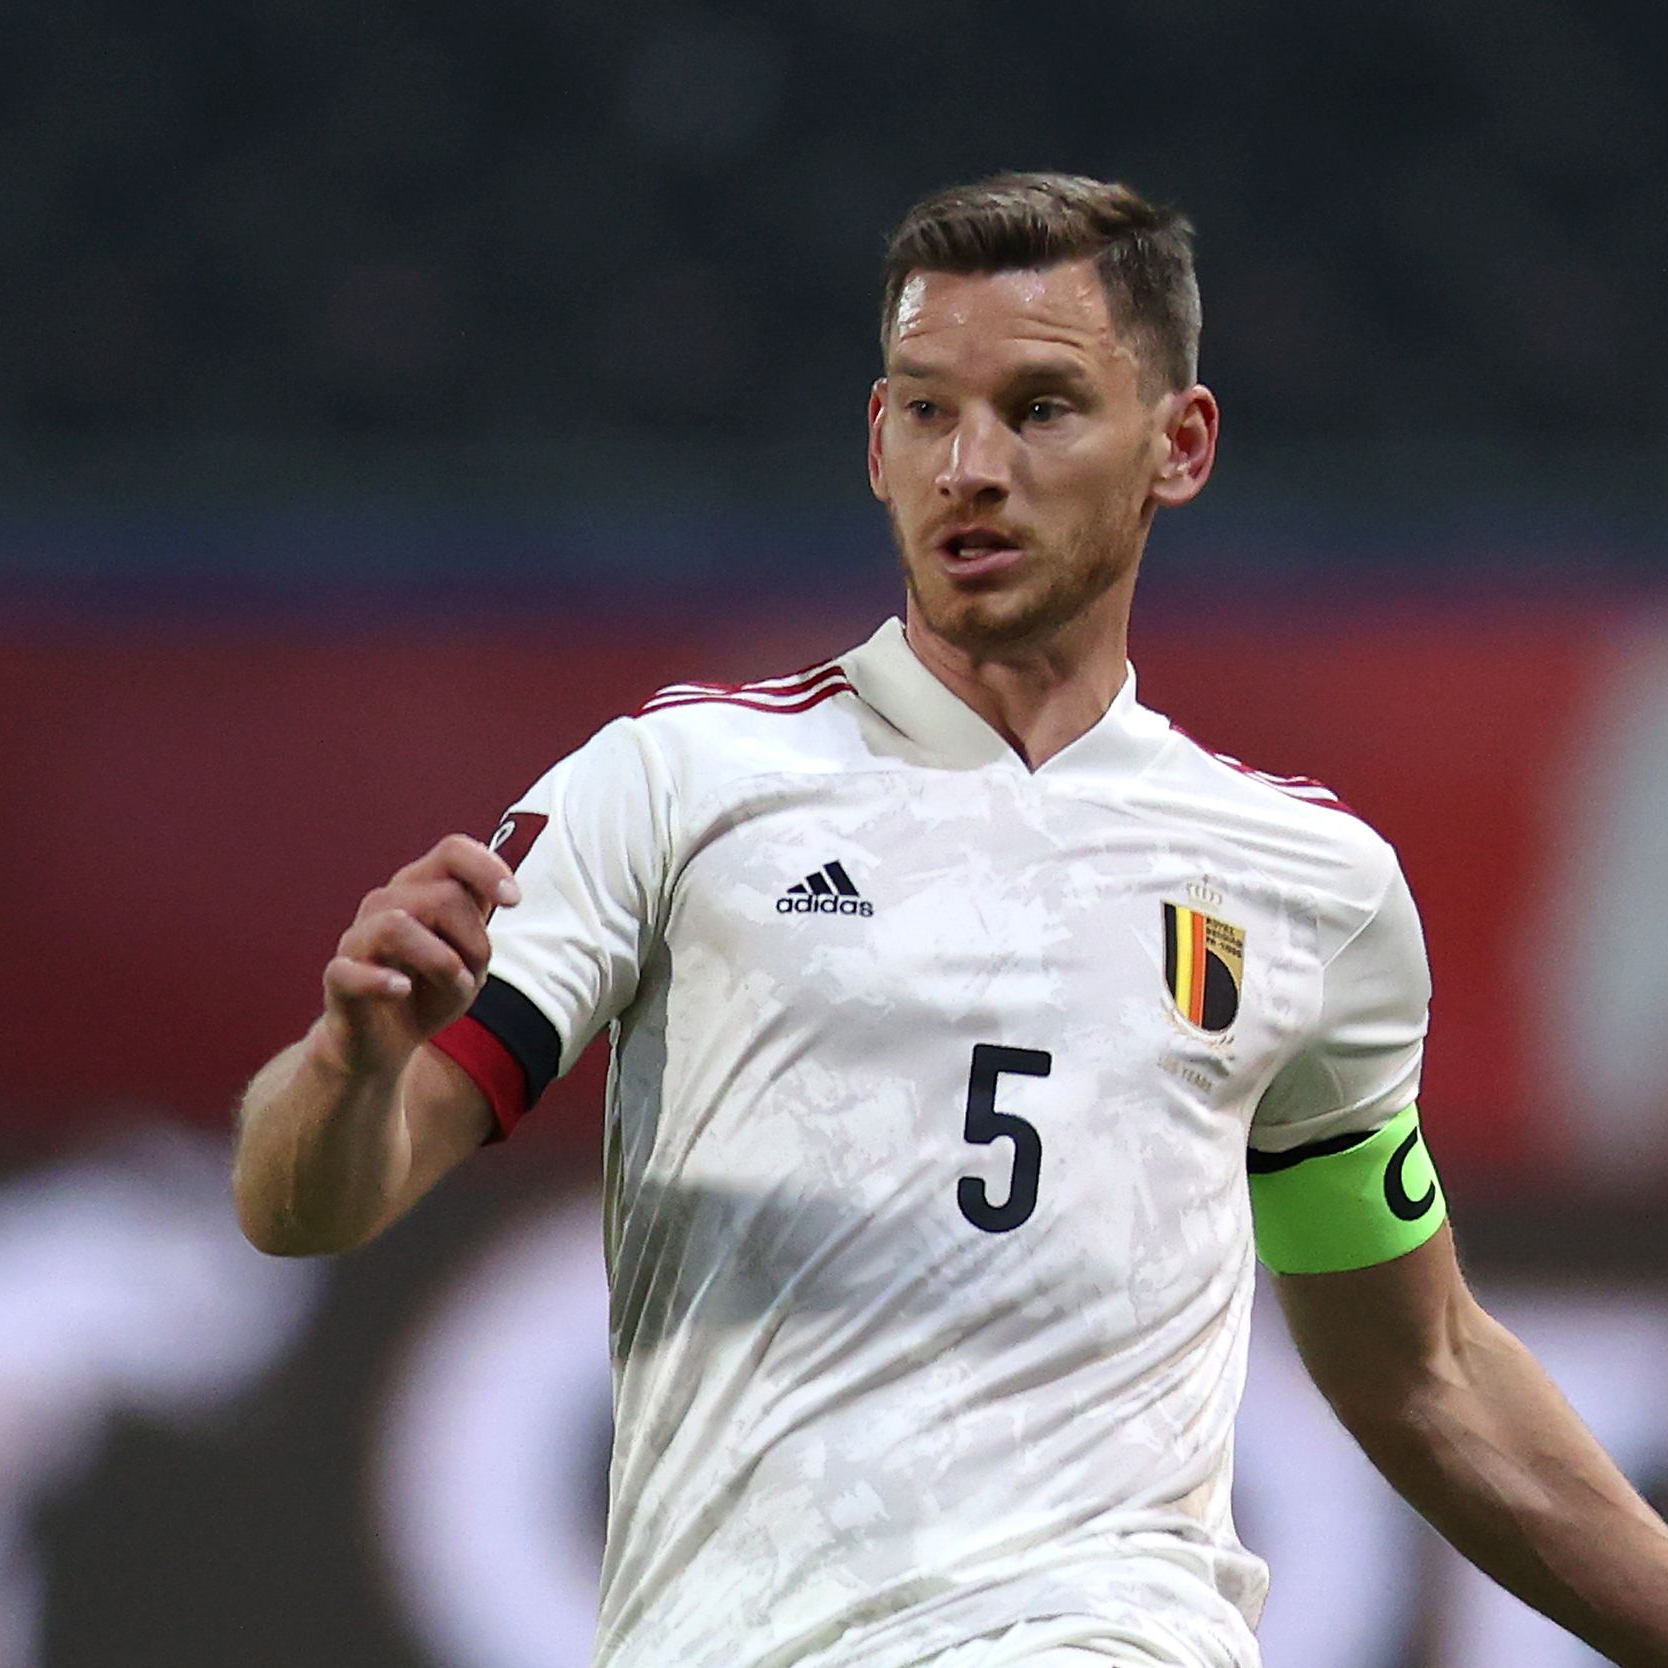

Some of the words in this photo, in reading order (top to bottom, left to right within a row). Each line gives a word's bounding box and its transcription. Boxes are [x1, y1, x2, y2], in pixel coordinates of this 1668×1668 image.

[776, 893, 874, 917] adidas
[957, 1043, 1052, 1233] 5
[1383, 1126, 1436, 1222] C
